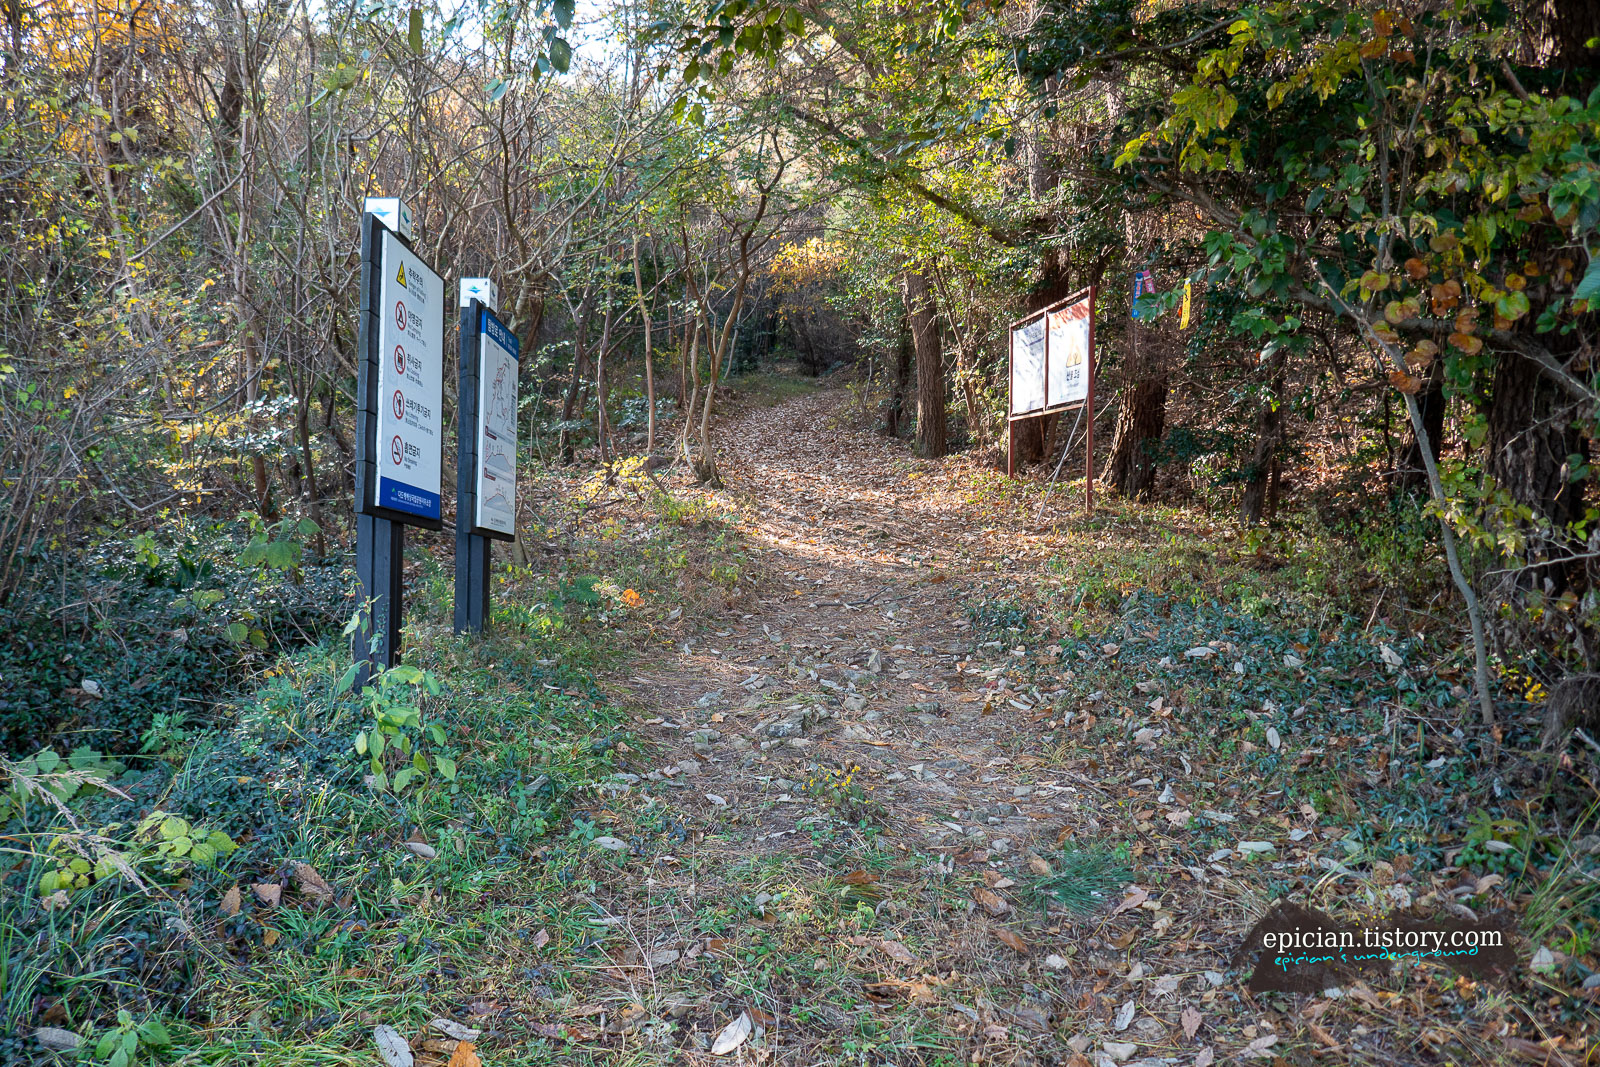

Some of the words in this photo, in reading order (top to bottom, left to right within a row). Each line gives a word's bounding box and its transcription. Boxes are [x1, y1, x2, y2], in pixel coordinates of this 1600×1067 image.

[408, 310, 423, 330] 야영금지
[498, 328, 506, 346] 안내
[406, 353, 422, 371] 취사금지
[405, 397, 431, 420] 쓰레기투기금지
[404, 441, 421, 459] 흡연금지
